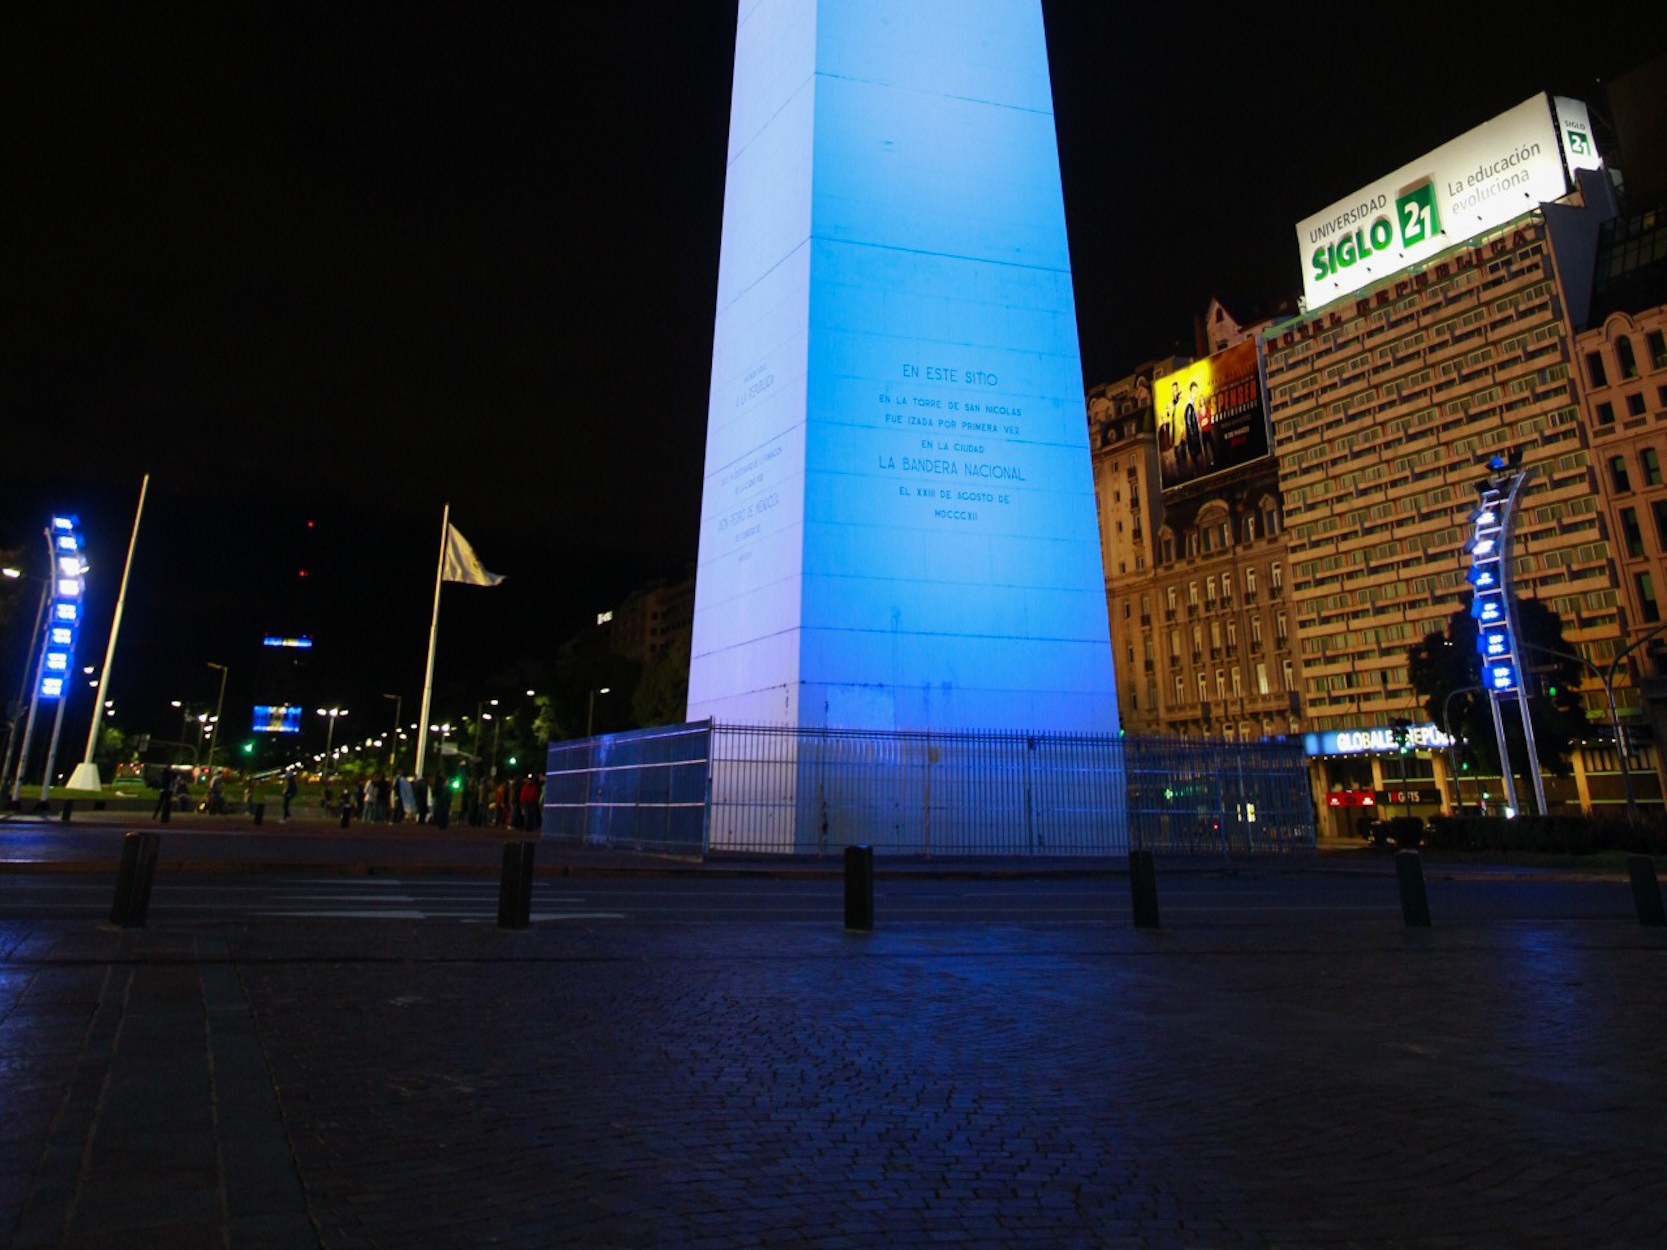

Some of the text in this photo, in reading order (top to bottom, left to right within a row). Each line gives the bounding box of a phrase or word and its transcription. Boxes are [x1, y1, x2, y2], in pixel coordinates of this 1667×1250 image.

[1564, 120, 1586, 130] SIGLO
[1571, 134, 1588, 154] 21
[1448, 141, 1541, 198] La educación
[1451, 169, 1531, 215] evoluciona
[1309, 193, 1387, 244] UNIVERSIDAD
[1312, 200, 1431, 282] SIGLO 21
[1267, 311, 1342, 352] HOTEL
[903, 364, 998, 386] EN ESTE SITIO
[879, 394, 1022, 417] EN LA TORRE DE SAN NICOLAS
[885, 414, 1020, 436] FUE IZADA POR PRIMERA VEZ
[921, 440, 985, 454] EN LA CIUDAD
[879, 455, 1026, 481] LA BANDERA NACIONAL
[899, 486, 910, 496] EL
[940, 489, 952, 500] DE
[957, 491, 993, 503] AGOSTO
[998, 494, 1010, 504] DE
[934, 509, 978, 521] MDCCCXII
[1336, 729, 1399, 752] GLOBALE
[1398, 790, 1421, 803] GFTS
